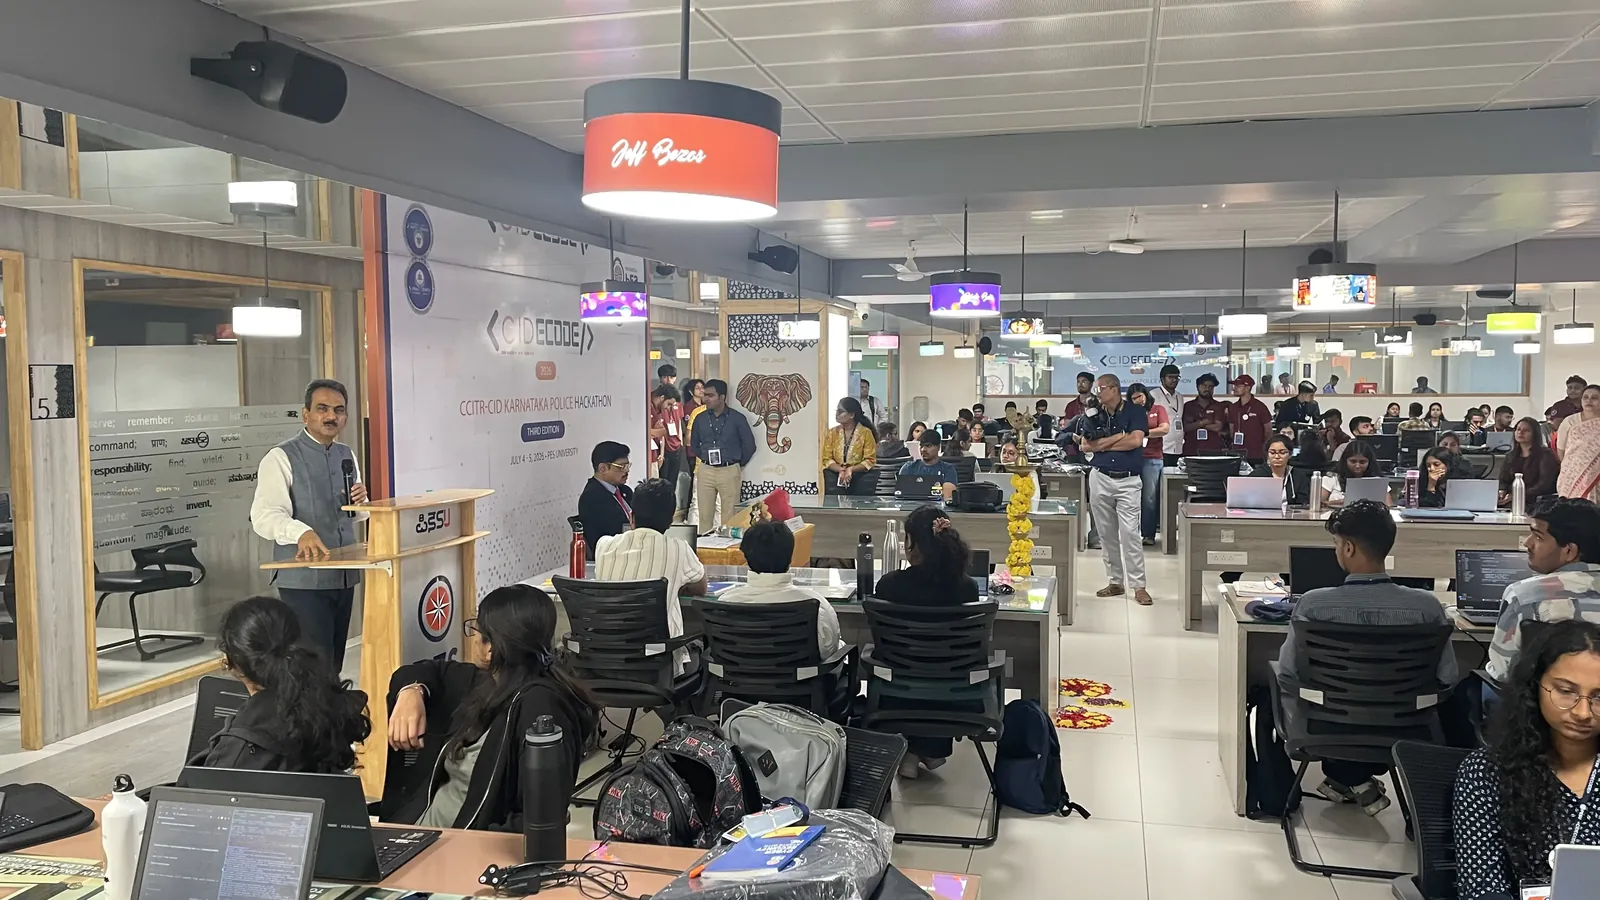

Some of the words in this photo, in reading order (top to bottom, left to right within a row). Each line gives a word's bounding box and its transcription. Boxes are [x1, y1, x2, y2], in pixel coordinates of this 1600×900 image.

[611, 138, 648, 168] Jeff
[652, 138, 707, 166] Bezos
[39, 398, 50, 419] 5
[459, 399, 503, 416] CCITR-CID
[504, 397, 549, 413] KARNATAKA
[550, 396, 574, 410] POLICE
[574, 394, 612, 409] HACKATHON
[127, 415, 174, 426] remember;
[527, 427, 541, 436] THIRD
[541, 425, 560, 435] EDITION
[89, 439, 137, 451] command;
[510, 455, 521, 465] JULY
[522, 454, 526, 462] 4
[547, 450, 556, 460] PES
